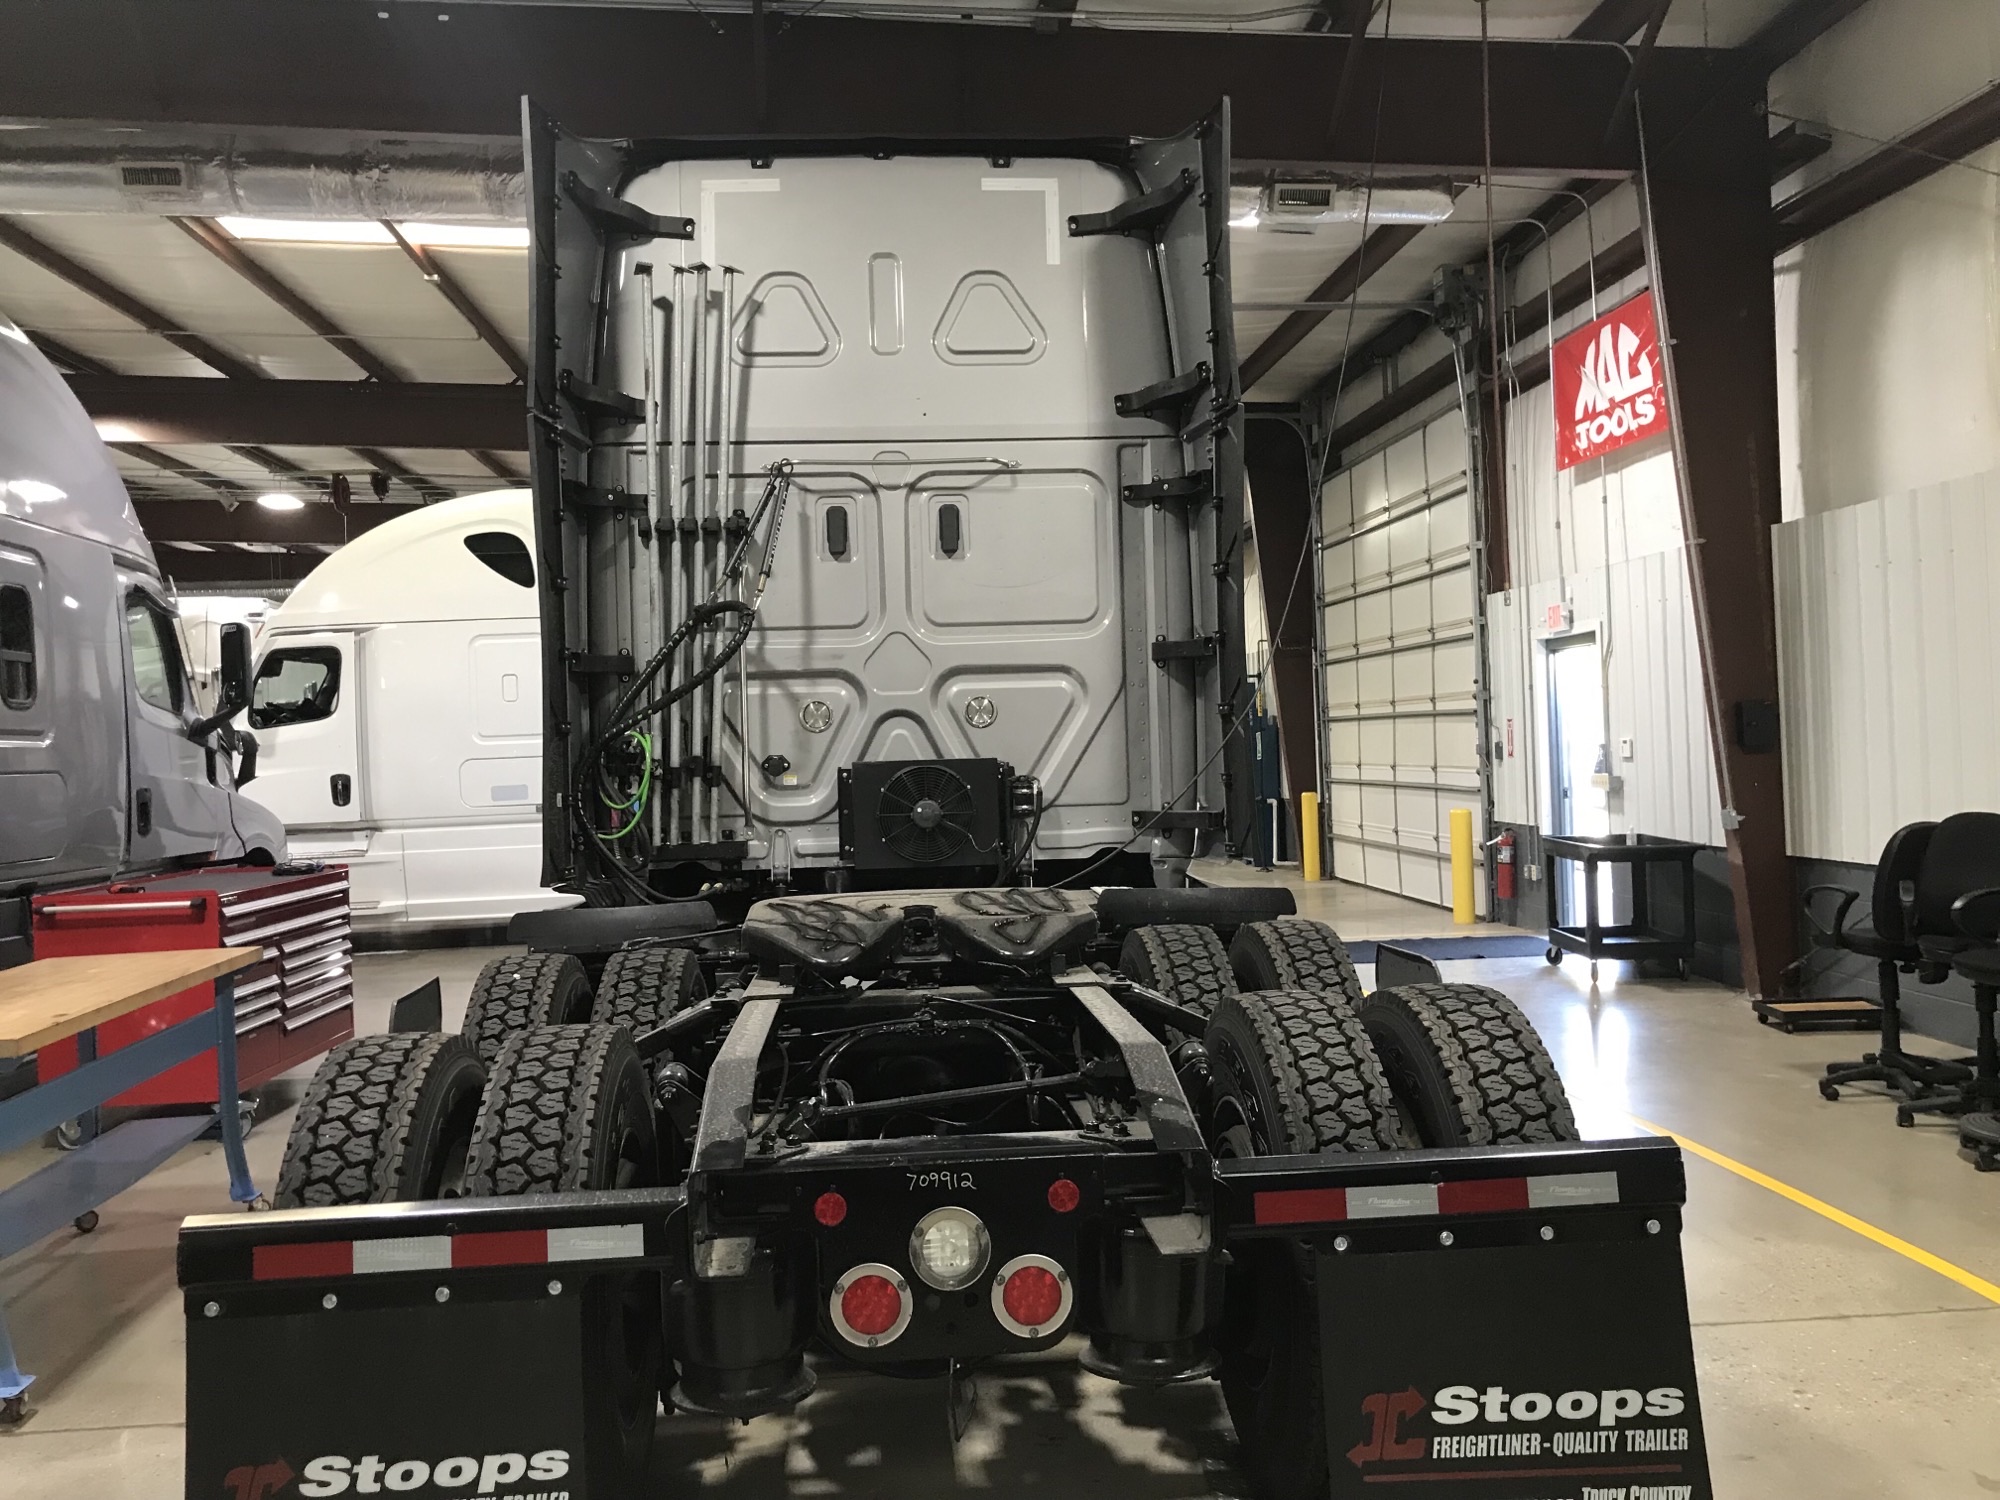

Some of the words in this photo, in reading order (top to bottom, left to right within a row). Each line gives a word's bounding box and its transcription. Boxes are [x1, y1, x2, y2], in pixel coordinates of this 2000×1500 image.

[1575, 323, 1653, 420] MAC
[1575, 394, 1656, 449] TOOLS
[906, 1171, 977, 1190] 709912
[1431, 1385, 1685, 1426] Stoops
[1624, 1428, 1689, 1452] TRAILER
[298, 1449, 570, 1497] Stoops
